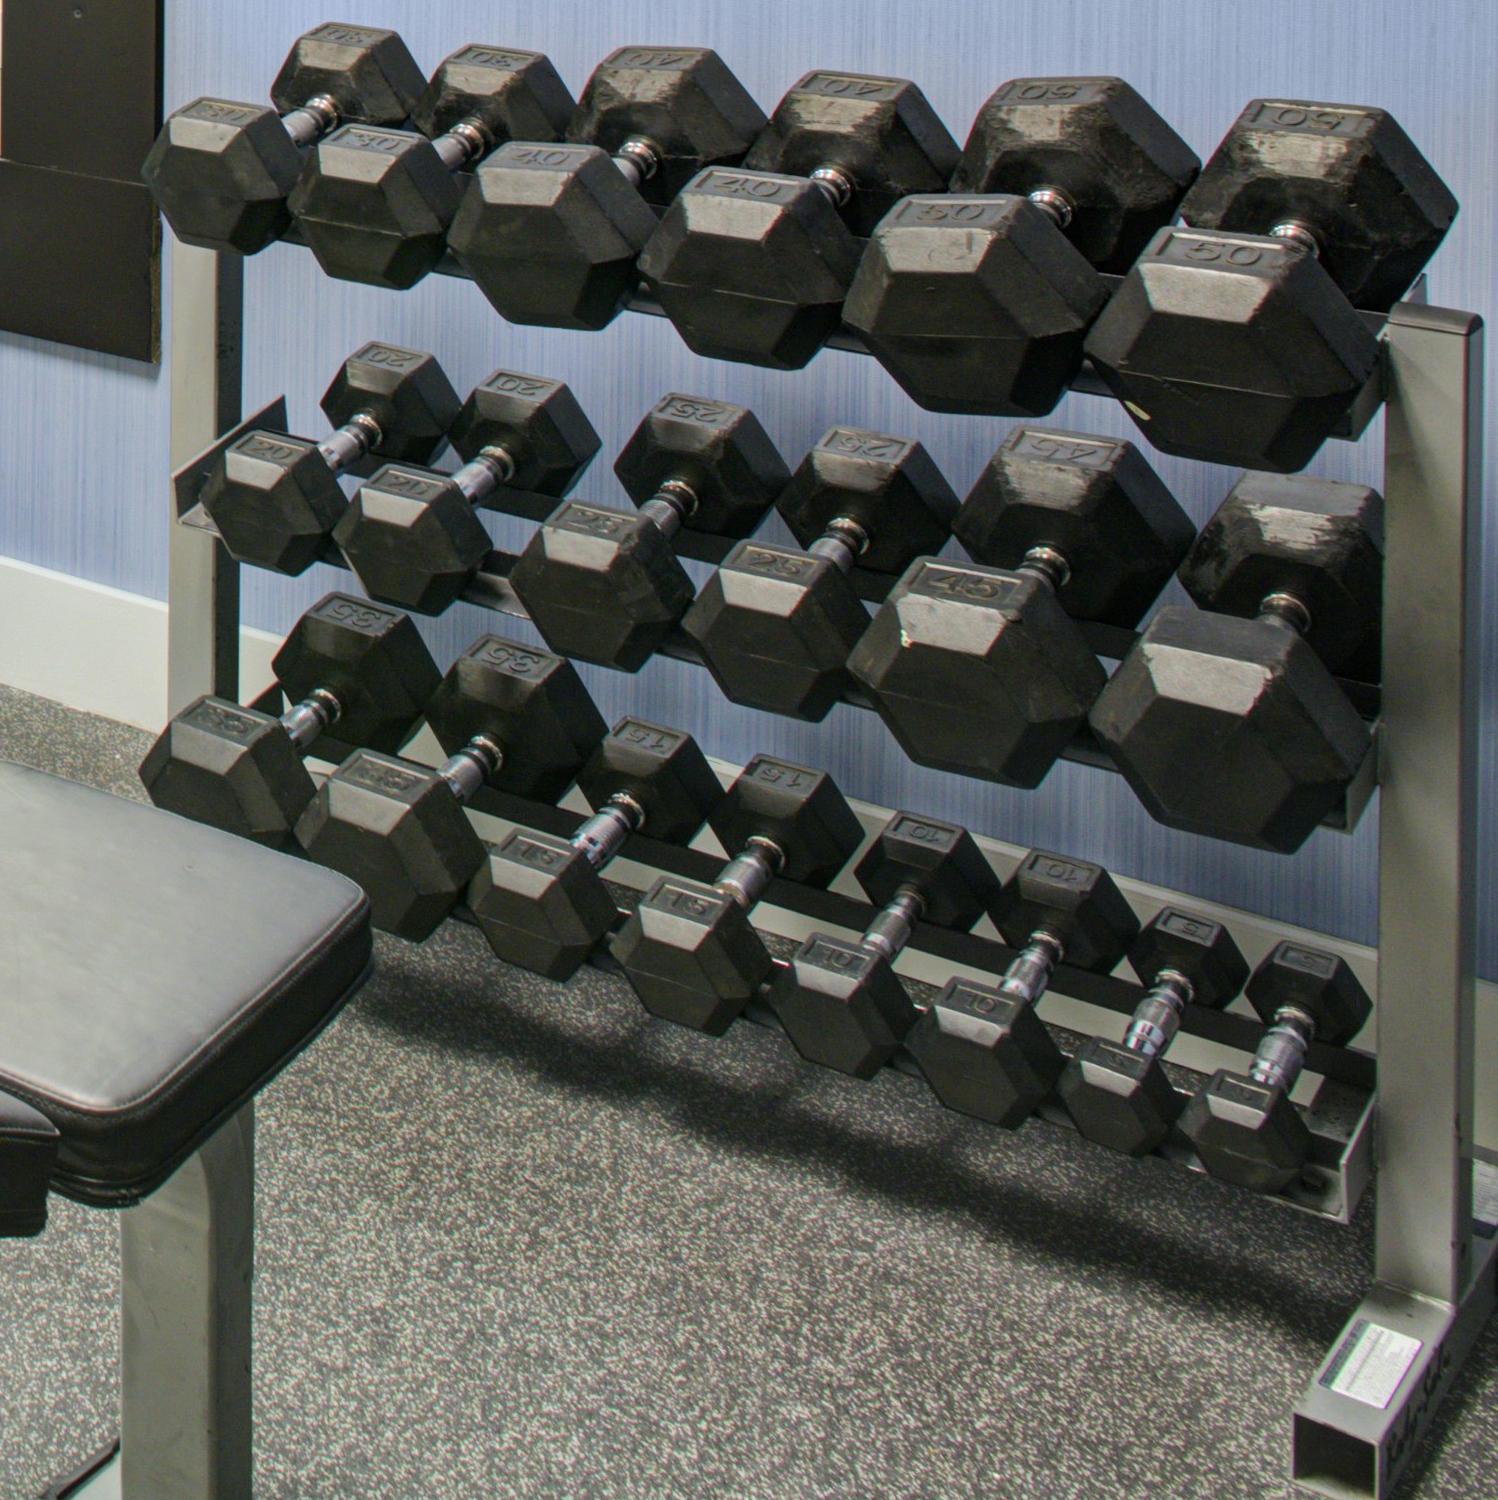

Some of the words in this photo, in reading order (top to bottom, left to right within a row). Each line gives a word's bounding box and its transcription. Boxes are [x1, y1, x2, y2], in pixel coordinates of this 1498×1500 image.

[820, 79, 882, 96] 40
[1016, 85, 1082, 100] 50
[1270, 109, 1346, 131] 50
[508, 150, 571, 166] 40
[713, 178, 782, 197] 40
[916, 204, 986, 221] 50
[1184, 242, 1263, 267] 50
[368, 349, 414, 367] 20
[496, 377, 546, 397] 20
[670, 403, 725, 423] 25
[836, 435, 895, 458] 25
[1031, 438, 1098, 461] 45
[745, 552, 806, 578] 25
[927, 574, 1000, 600] 45
[325, 603, 382, 630] 35
[482, 647, 542, 674] 35
[625, 729, 666, 749] 15
[760, 767, 803, 789] 15
[909, 825, 941, 843] 10
[1045, 863, 1080, 882] 10
